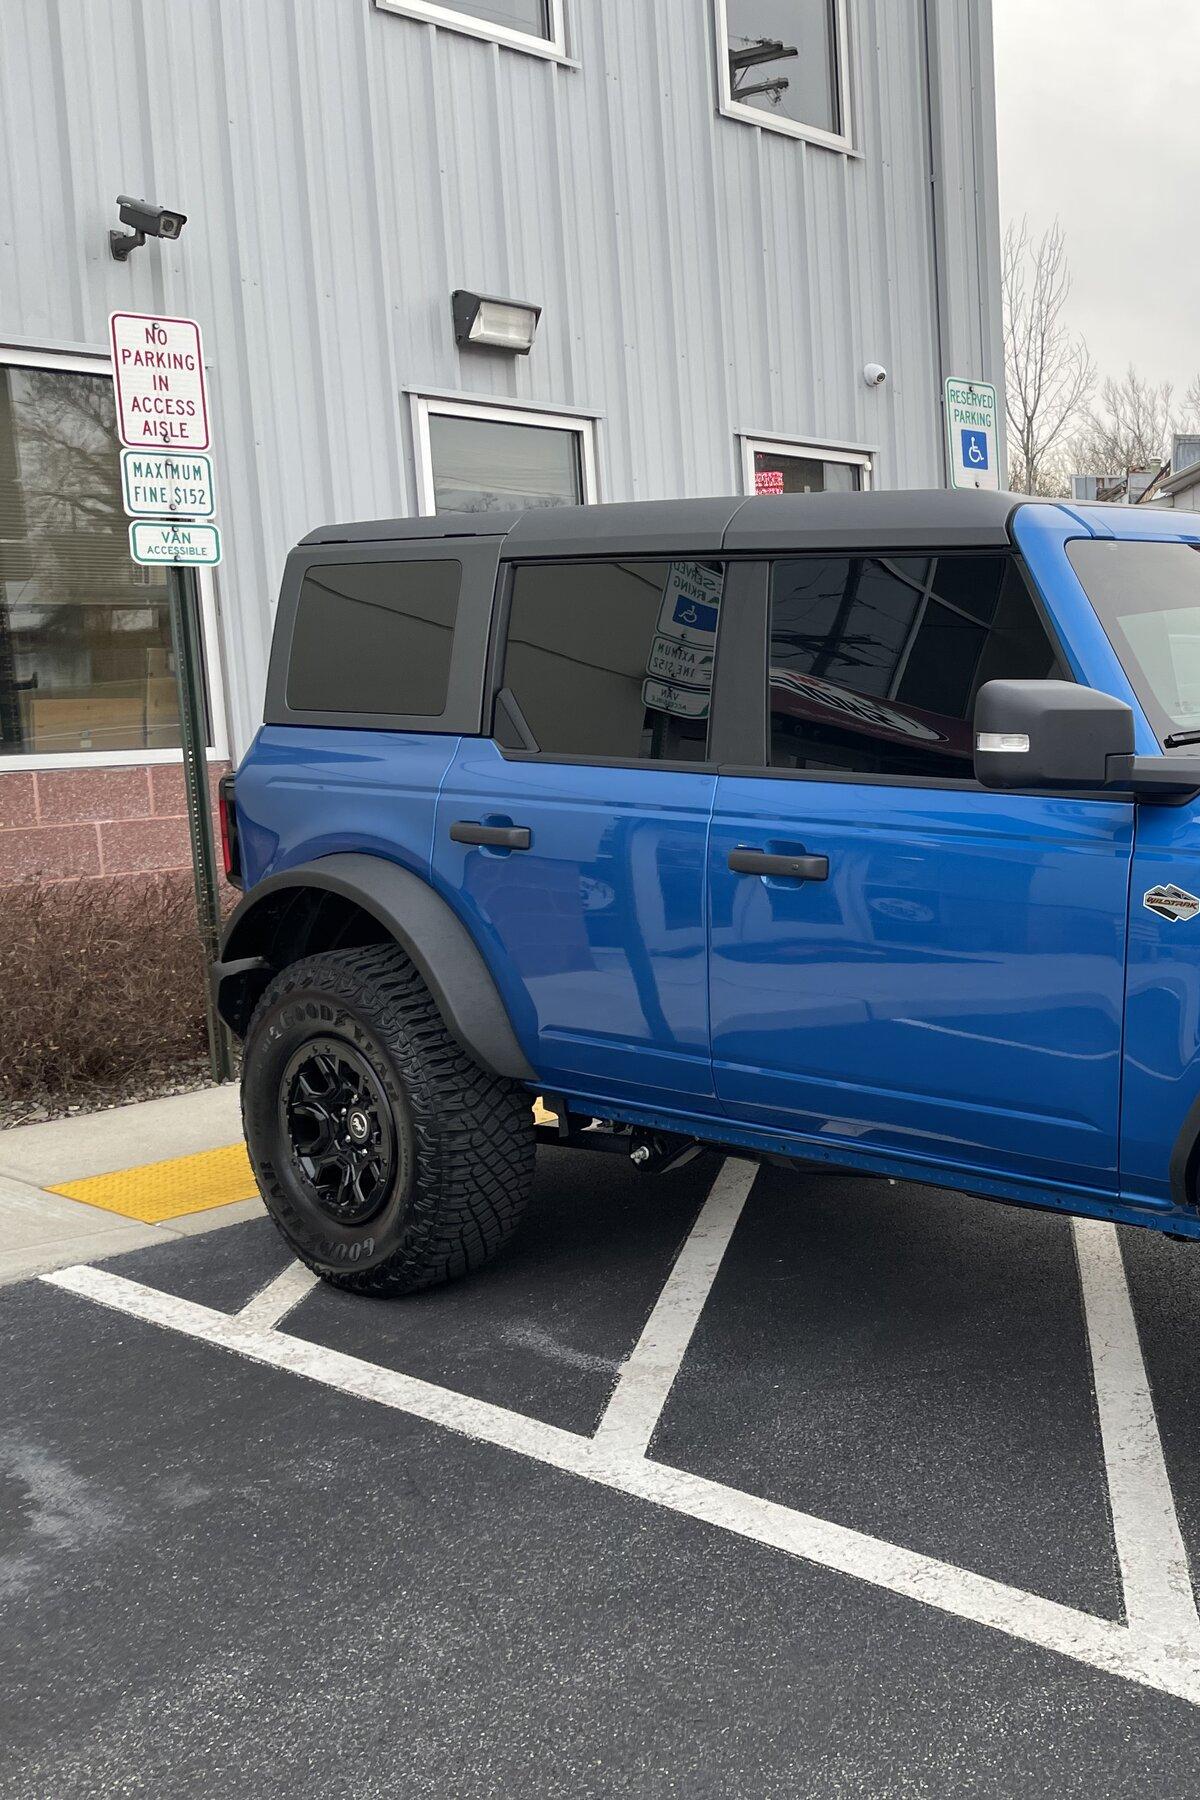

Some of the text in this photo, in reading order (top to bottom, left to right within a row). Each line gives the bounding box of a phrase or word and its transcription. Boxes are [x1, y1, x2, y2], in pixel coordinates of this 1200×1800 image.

[145, 328, 168, 346] NO
[122, 349, 195, 371] PARKING
[153, 375, 169, 392] IN
[131, 396, 195, 416] ACCESS
[950, 389, 993, 409] RESERVED
[954, 409, 992, 427] PARKING
[143, 420, 189, 438] AISLE
[134, 462, 202, 481] MAXIMUM
[135, 487, 206, 505] FINE $152
[162, 532, 191, 544] VAN
[147, 546, 208, 556] ACCESSIBLE
